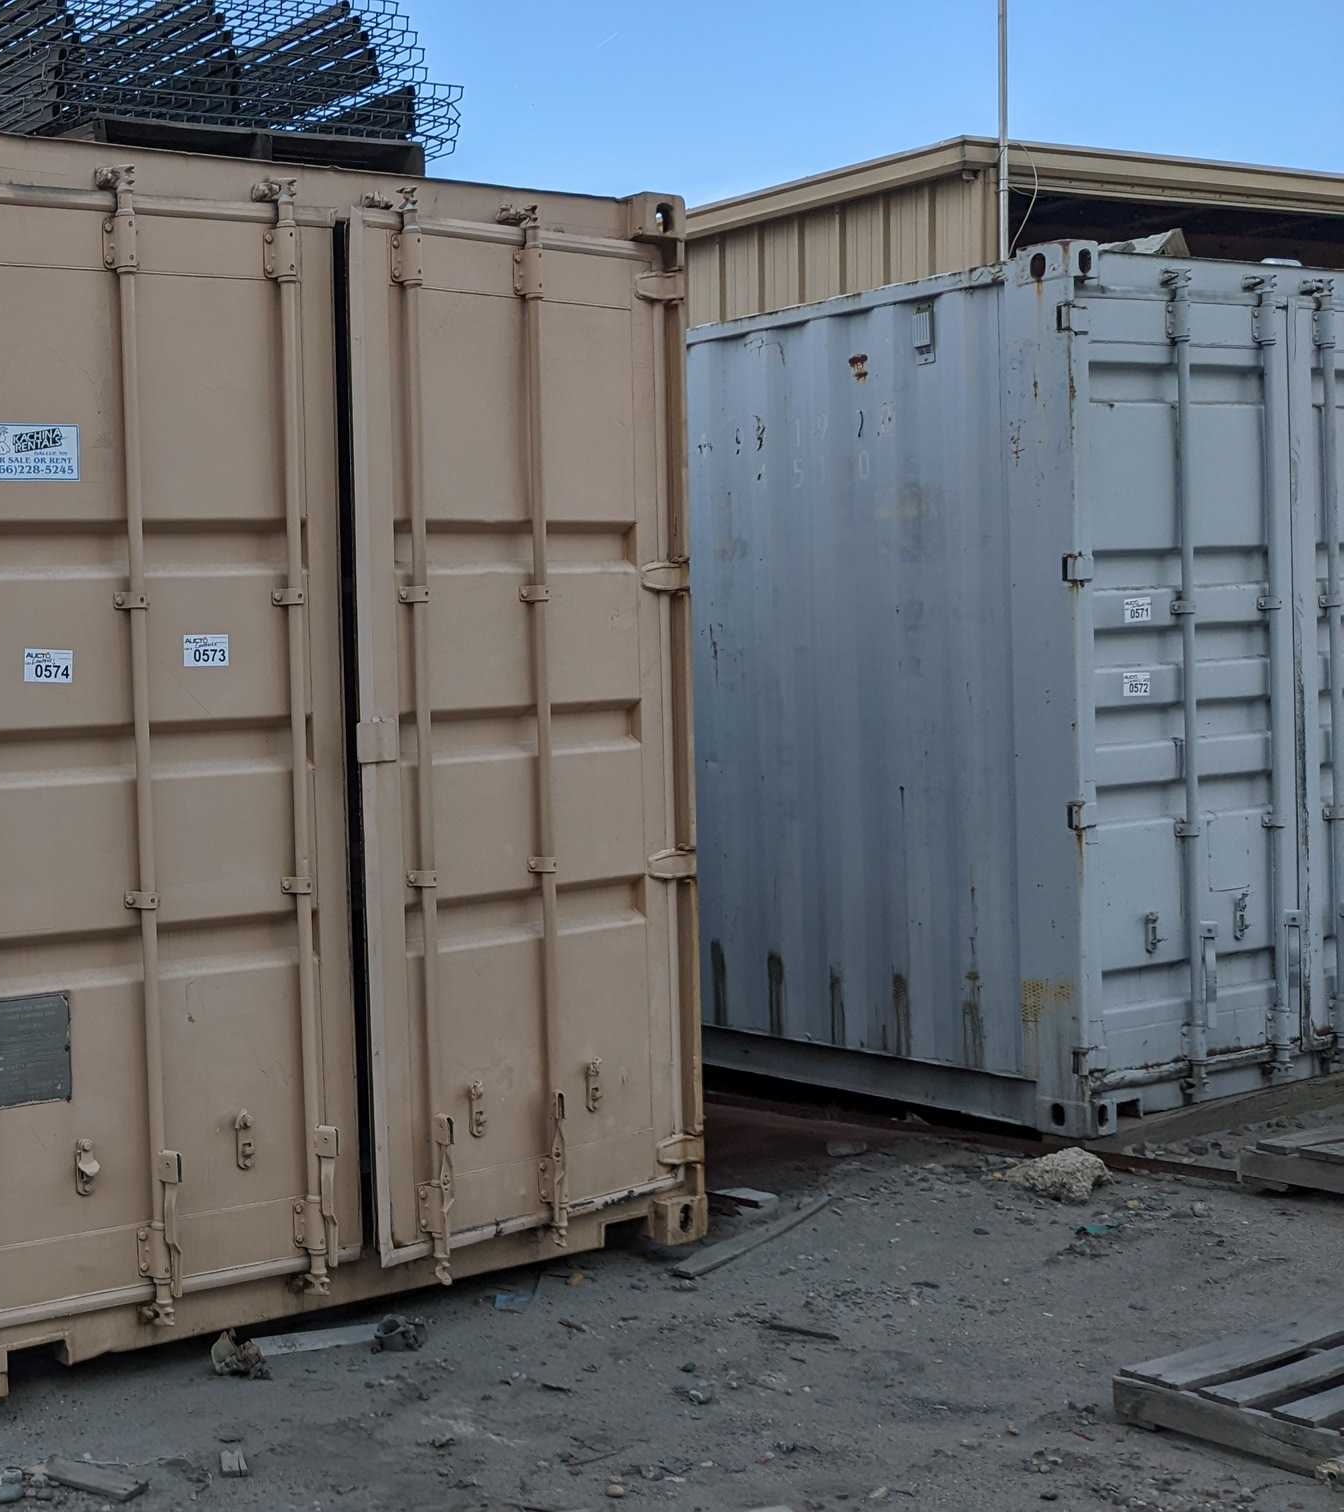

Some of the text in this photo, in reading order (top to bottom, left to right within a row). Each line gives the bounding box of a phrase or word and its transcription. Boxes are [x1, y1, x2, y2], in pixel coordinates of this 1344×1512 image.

[13, 428, 62, 445] KACHINA
[14, 436, 62, 453] RENTALS
[49, 457, 73, 465] RENT
[1130, 607, 1149, 619] 0571
[194, 648, 226, 662] 0573
[35, 664, 70, 679] 0574
[1129, 683, 1149, 694] 0572
